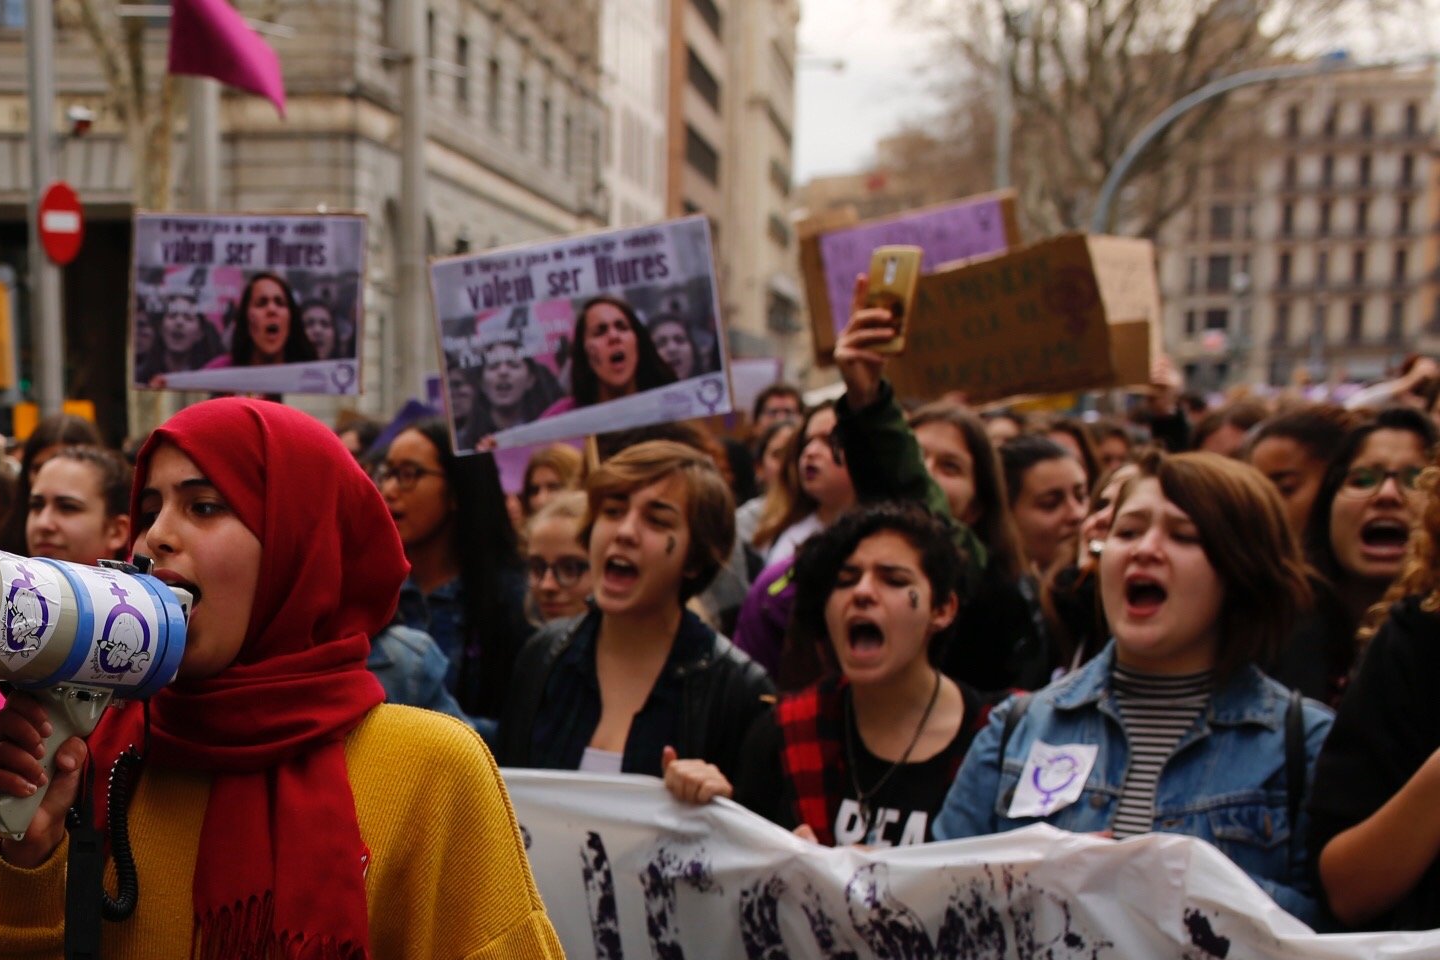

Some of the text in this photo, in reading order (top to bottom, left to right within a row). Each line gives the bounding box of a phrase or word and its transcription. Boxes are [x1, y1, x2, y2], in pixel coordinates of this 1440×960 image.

[225, 242, 256, 265] ser
[467, 274, 535, 310] volem
[546, 267, 583, 297] ser
[595, 253, 670, 290] lliures
